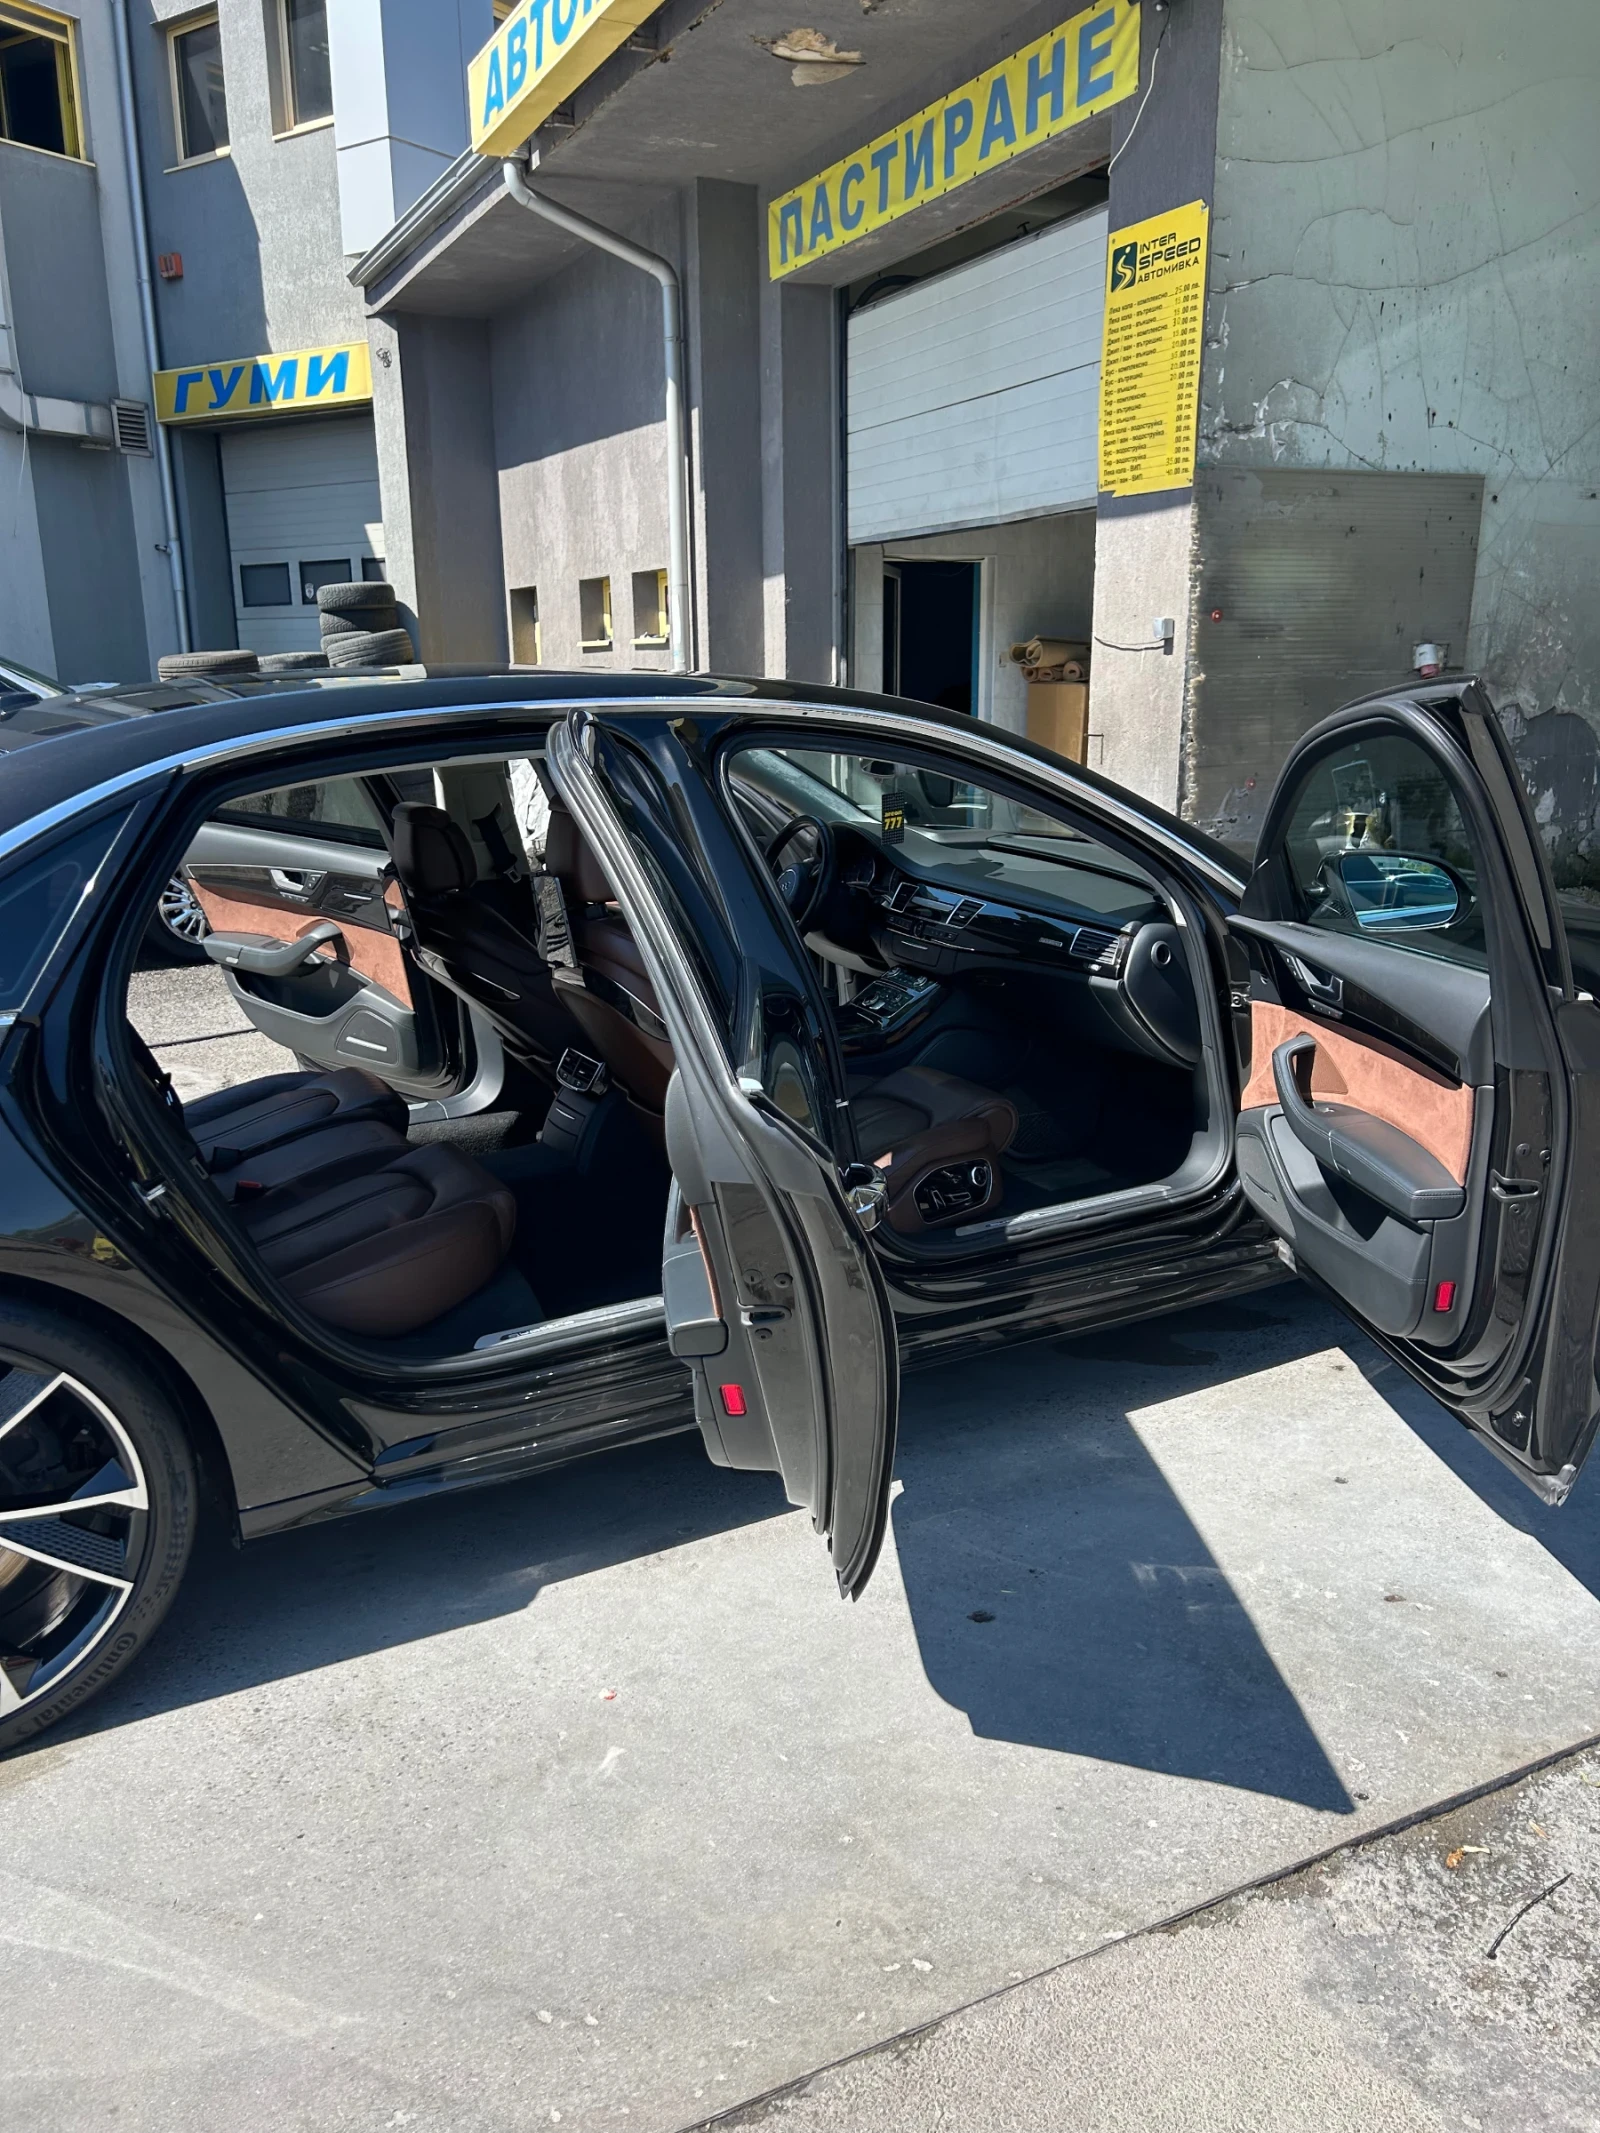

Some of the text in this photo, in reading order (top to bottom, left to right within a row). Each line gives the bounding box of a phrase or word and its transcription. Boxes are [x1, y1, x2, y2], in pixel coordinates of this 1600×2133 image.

[483, 0, 602, 129] АВТО
[779, 7, 1115, 265] ПАСТИРАНЕ
[1138, 236, 1200, 270] SPEED
[1140, 232, 1176, 254] INTER
[1137, 256, 1200, 284] АВТОМИВКА
[174, 350, 350, 414] ГУМИ
[884, 816, 902, 830] 777
[31, 1631, 138, 1728] Continental
